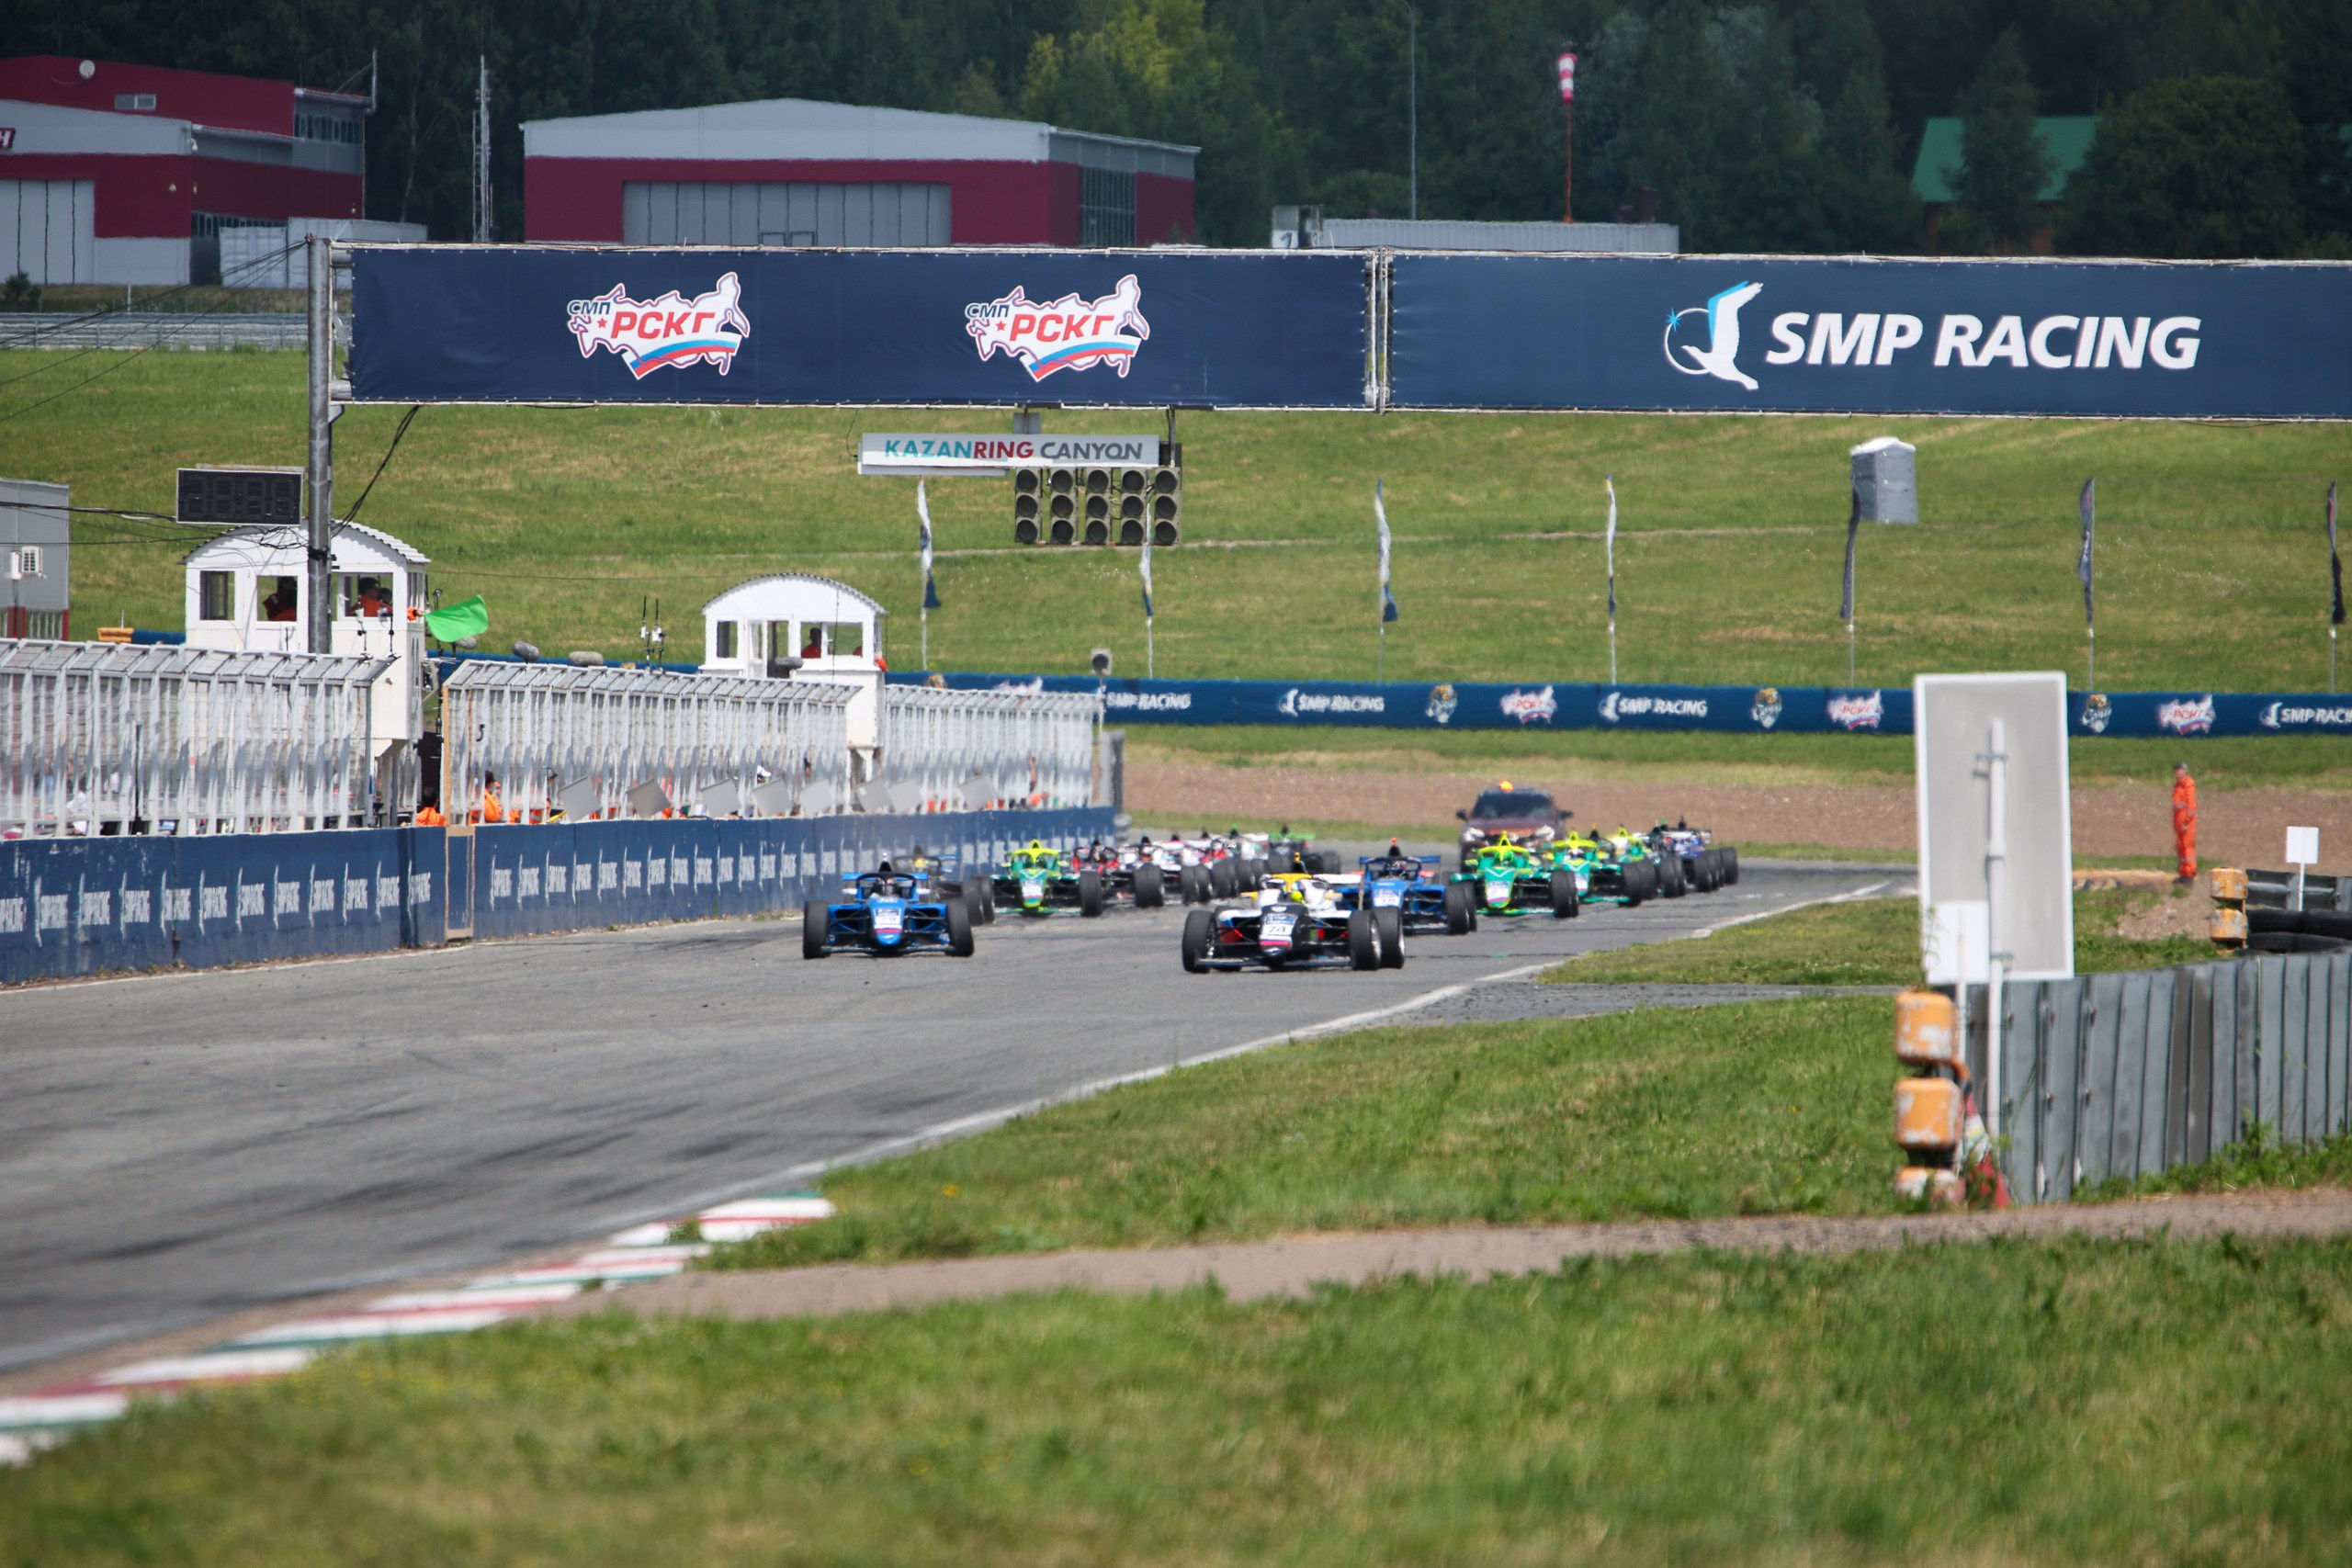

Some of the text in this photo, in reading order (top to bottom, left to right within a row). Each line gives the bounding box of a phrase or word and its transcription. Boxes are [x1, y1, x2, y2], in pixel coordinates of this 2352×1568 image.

[569, 301, 610, 315] СМП
[967, 304, 1010, 318] СМП
[610, 311, 716, 340] РСКГ
[1009, 313, 1114, 342] РСКГ
[1765, 311, 2201, 369] SMP RACING
[1040, 442, 1143, 460] CANYON
[1653, 698, 1708, 716] RACING
[2281, 707, 2314, 724] SMP
